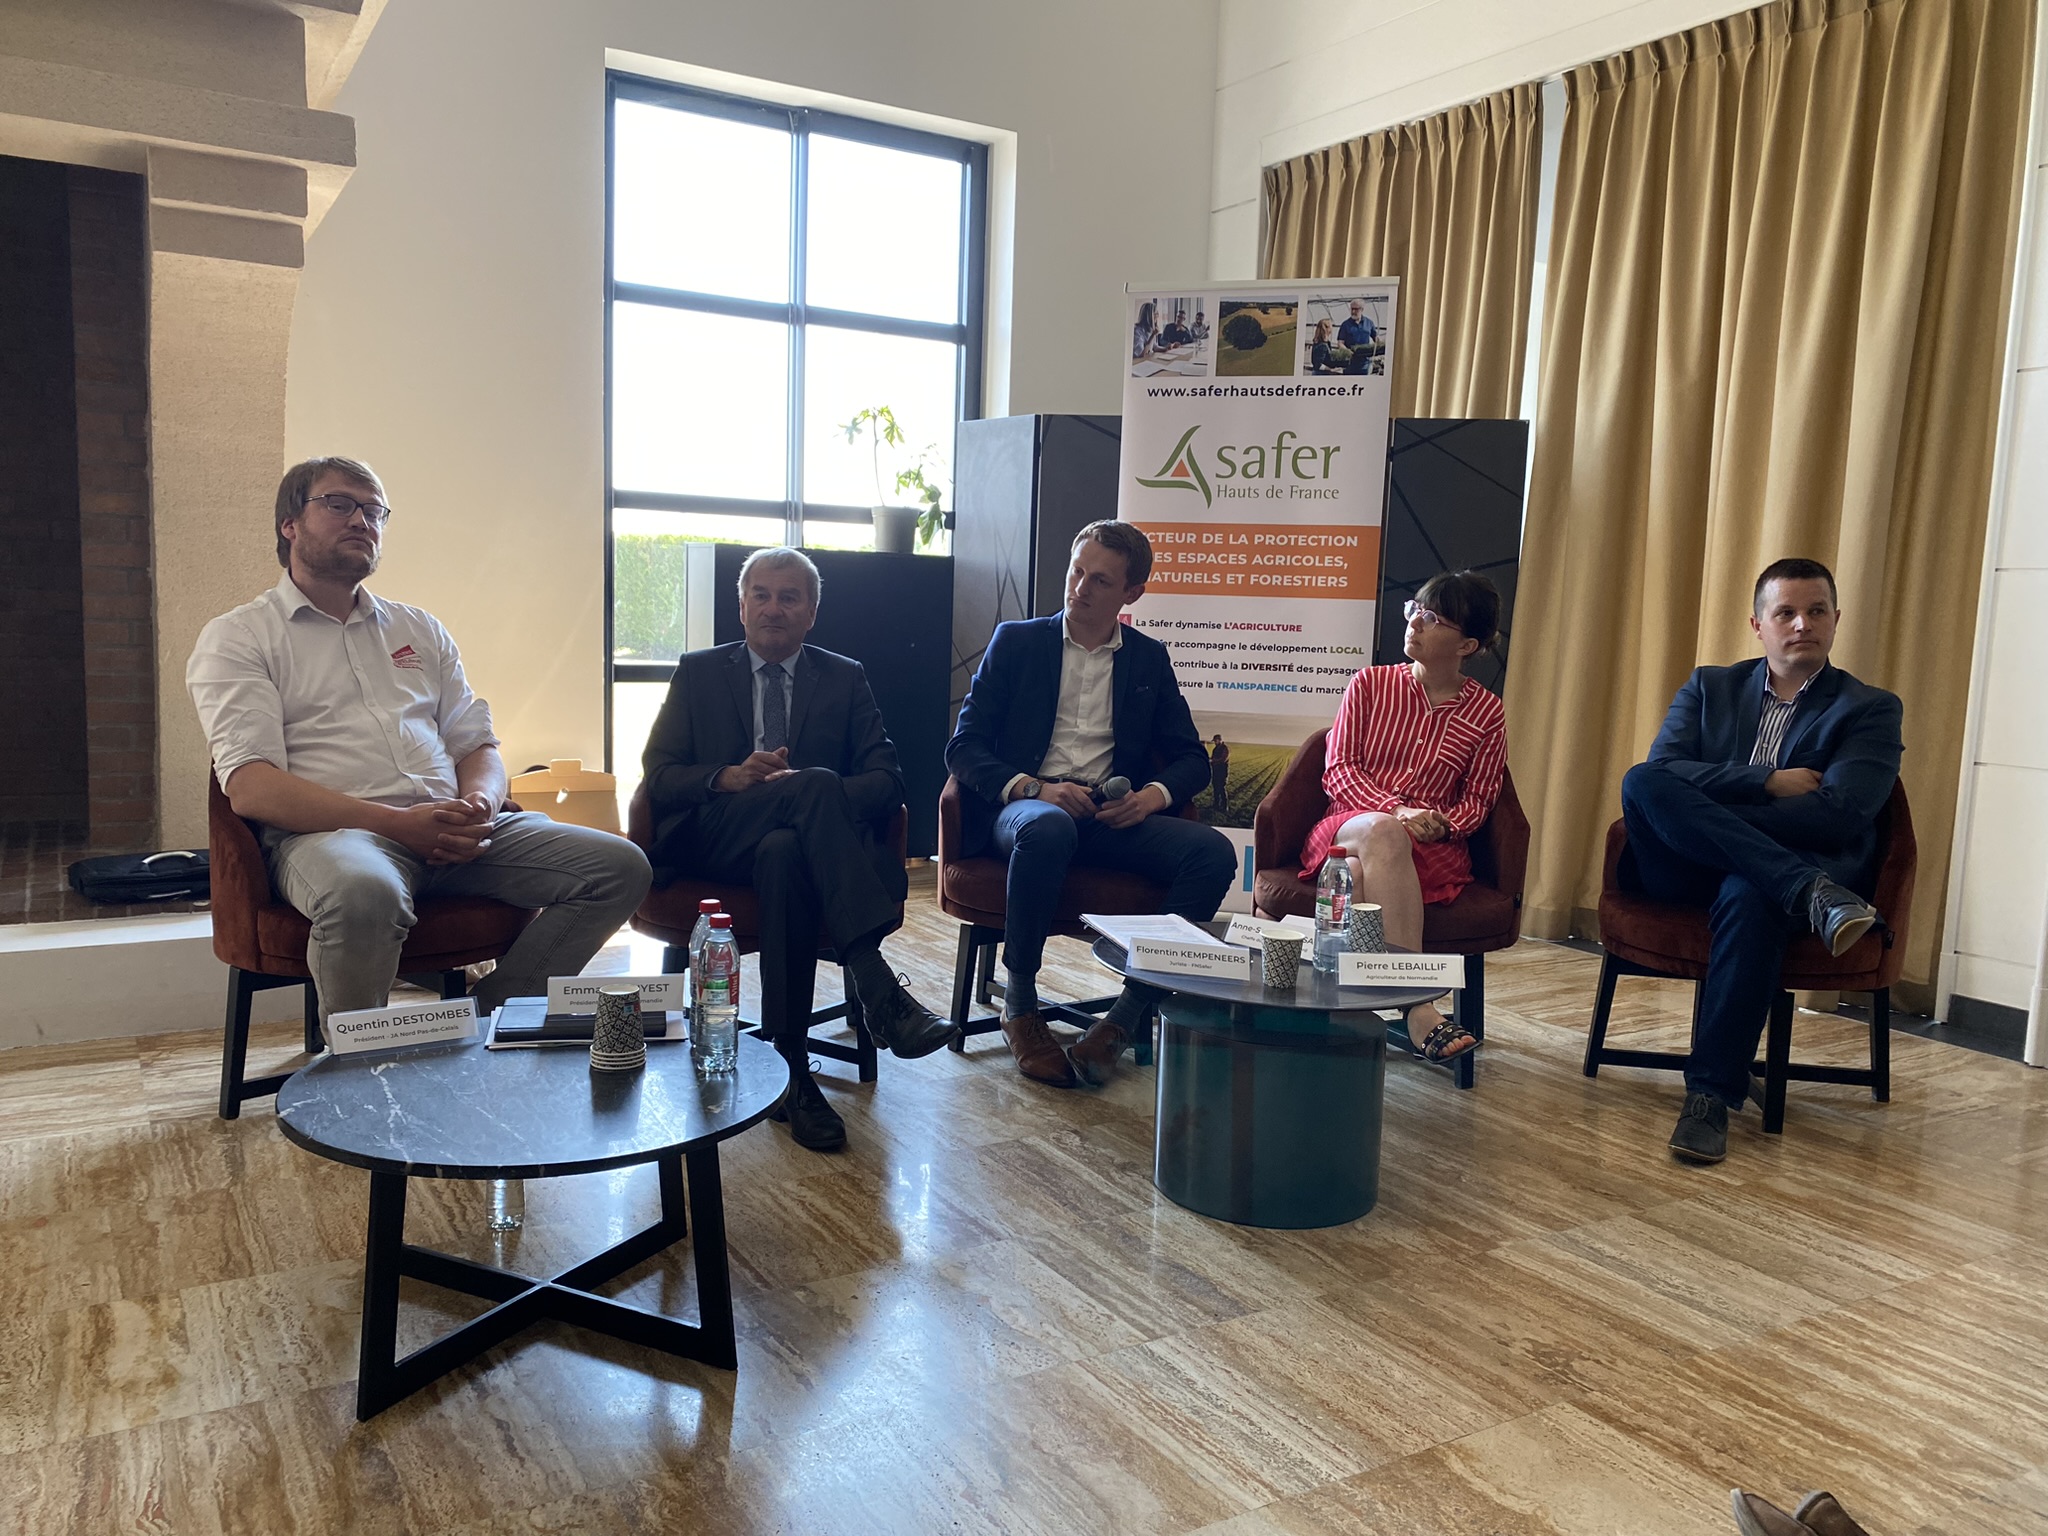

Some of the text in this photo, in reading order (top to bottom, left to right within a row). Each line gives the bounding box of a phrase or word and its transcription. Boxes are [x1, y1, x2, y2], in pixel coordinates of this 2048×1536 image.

[1147, 384, 1364, 398] www.saferhautsdefrance.fr
[1215, 430, 1341, 480] safer
[1216, 484, 1340, 500] Hauts de France
[1144, 531, 1358, 547] CTEUR DE LA PROTECTION
[1154, 551, 1348, 570] ES ESPACES AGRICOLES,
[1226, 573, 1245, 585] ET
[1249, 574, 1348, 588] FORESTIERS
[1135, 619, 1302, 632] La Safer dynamise L'AGRICULTURE
[1174, 641, 1236, 652] accompagne
[1238, 642, 1247, 650] le
[1249, 643, 1328, 654] développement
[1329, 646, 1364, 655] LOCAL
[1173, 660, 1220, 669] contribue
[1221, 661, 1228, 669] à
[1230, 661, 1238, 670] la
[1241, 662, 1294, 672] DIVERSITÉ
[1296, 664, 1314, 673] des
[1205, 680, 1213, 689] la
[1216, 681, 1297, 692] TRANSPARENCE
[1299, 685, 1313, 693] du
[1231, 921, 1262, 934] Anne-S
[1136, 945, 1246, 964] Florentin KEMPENEERS
[1356, 961, 1447, 971] Pierre LEBAILLIF
[563, 983, 670, 995] Emma YEST
[336, 1008, 471, 1034] Quentin DESTOMBES
[353, 1034, 385, 1043] Président
[417, 1025, 459, 1035] Pas-de-Calais
